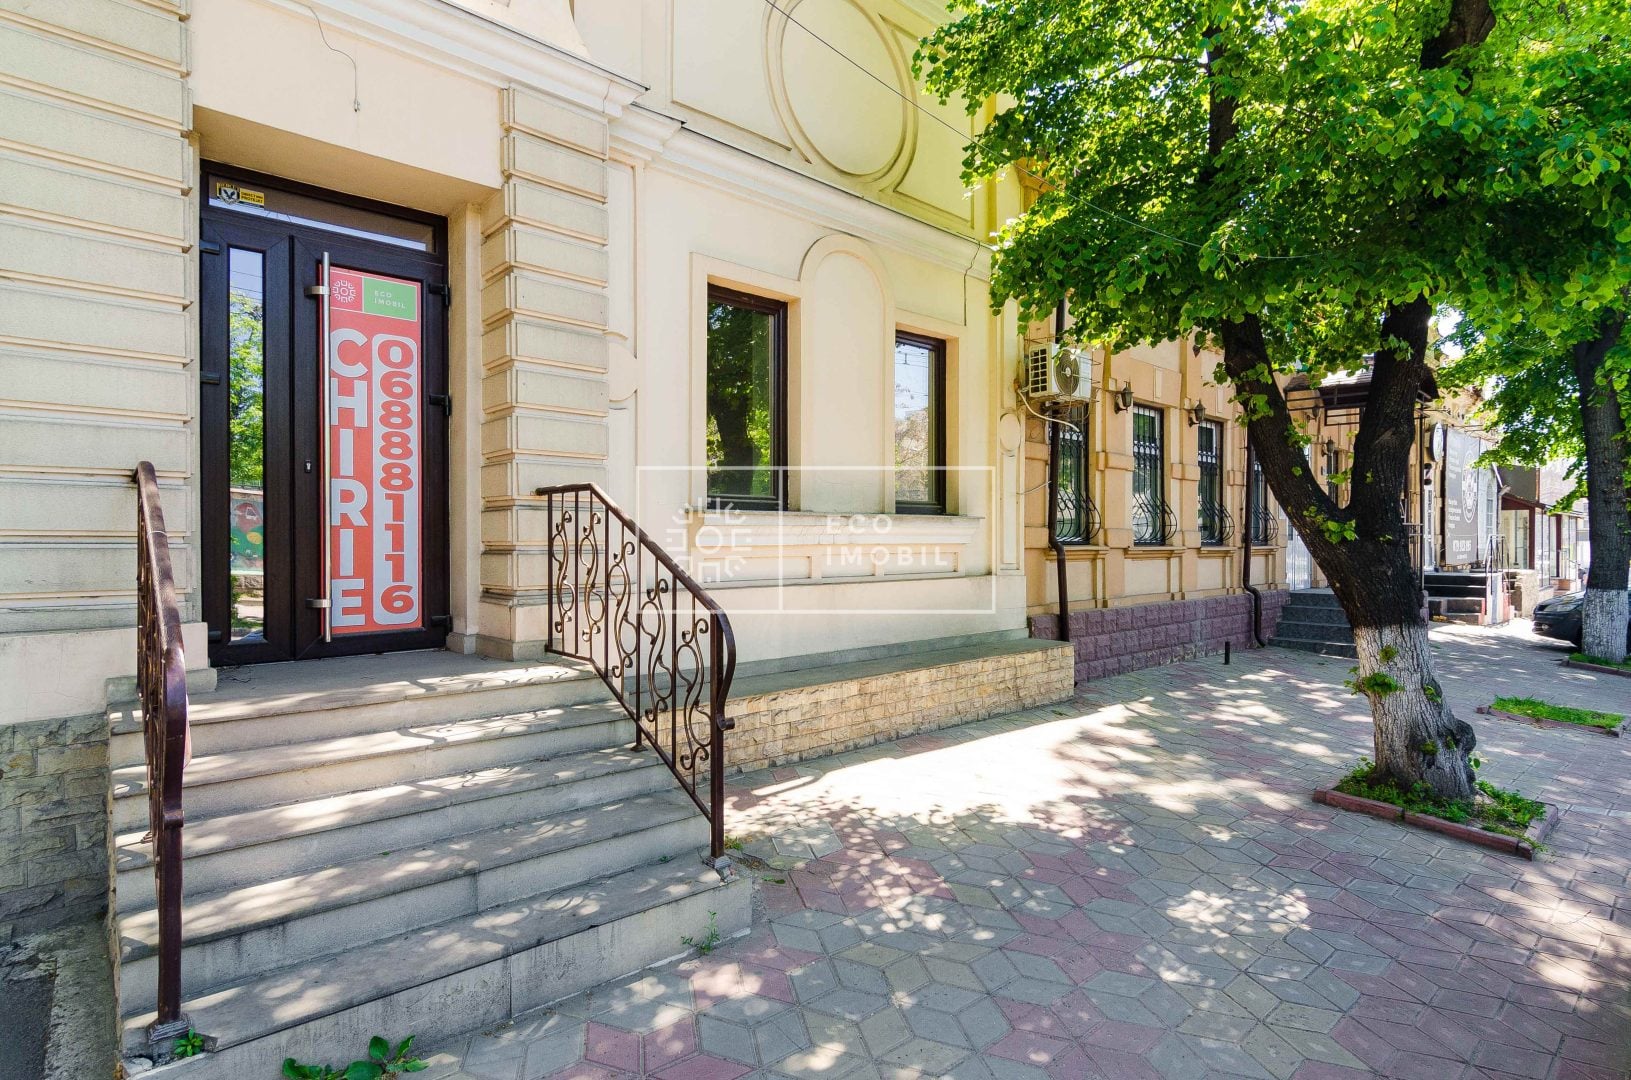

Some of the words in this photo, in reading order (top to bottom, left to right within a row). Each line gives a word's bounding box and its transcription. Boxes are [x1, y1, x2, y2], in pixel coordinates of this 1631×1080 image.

[374, 289, 393, 298] ECO
[374, 297, 406, 309] IMOBIL
[330, 328, 368, 627] CHIRIE
[378, 339, 414, 614] 068881116
